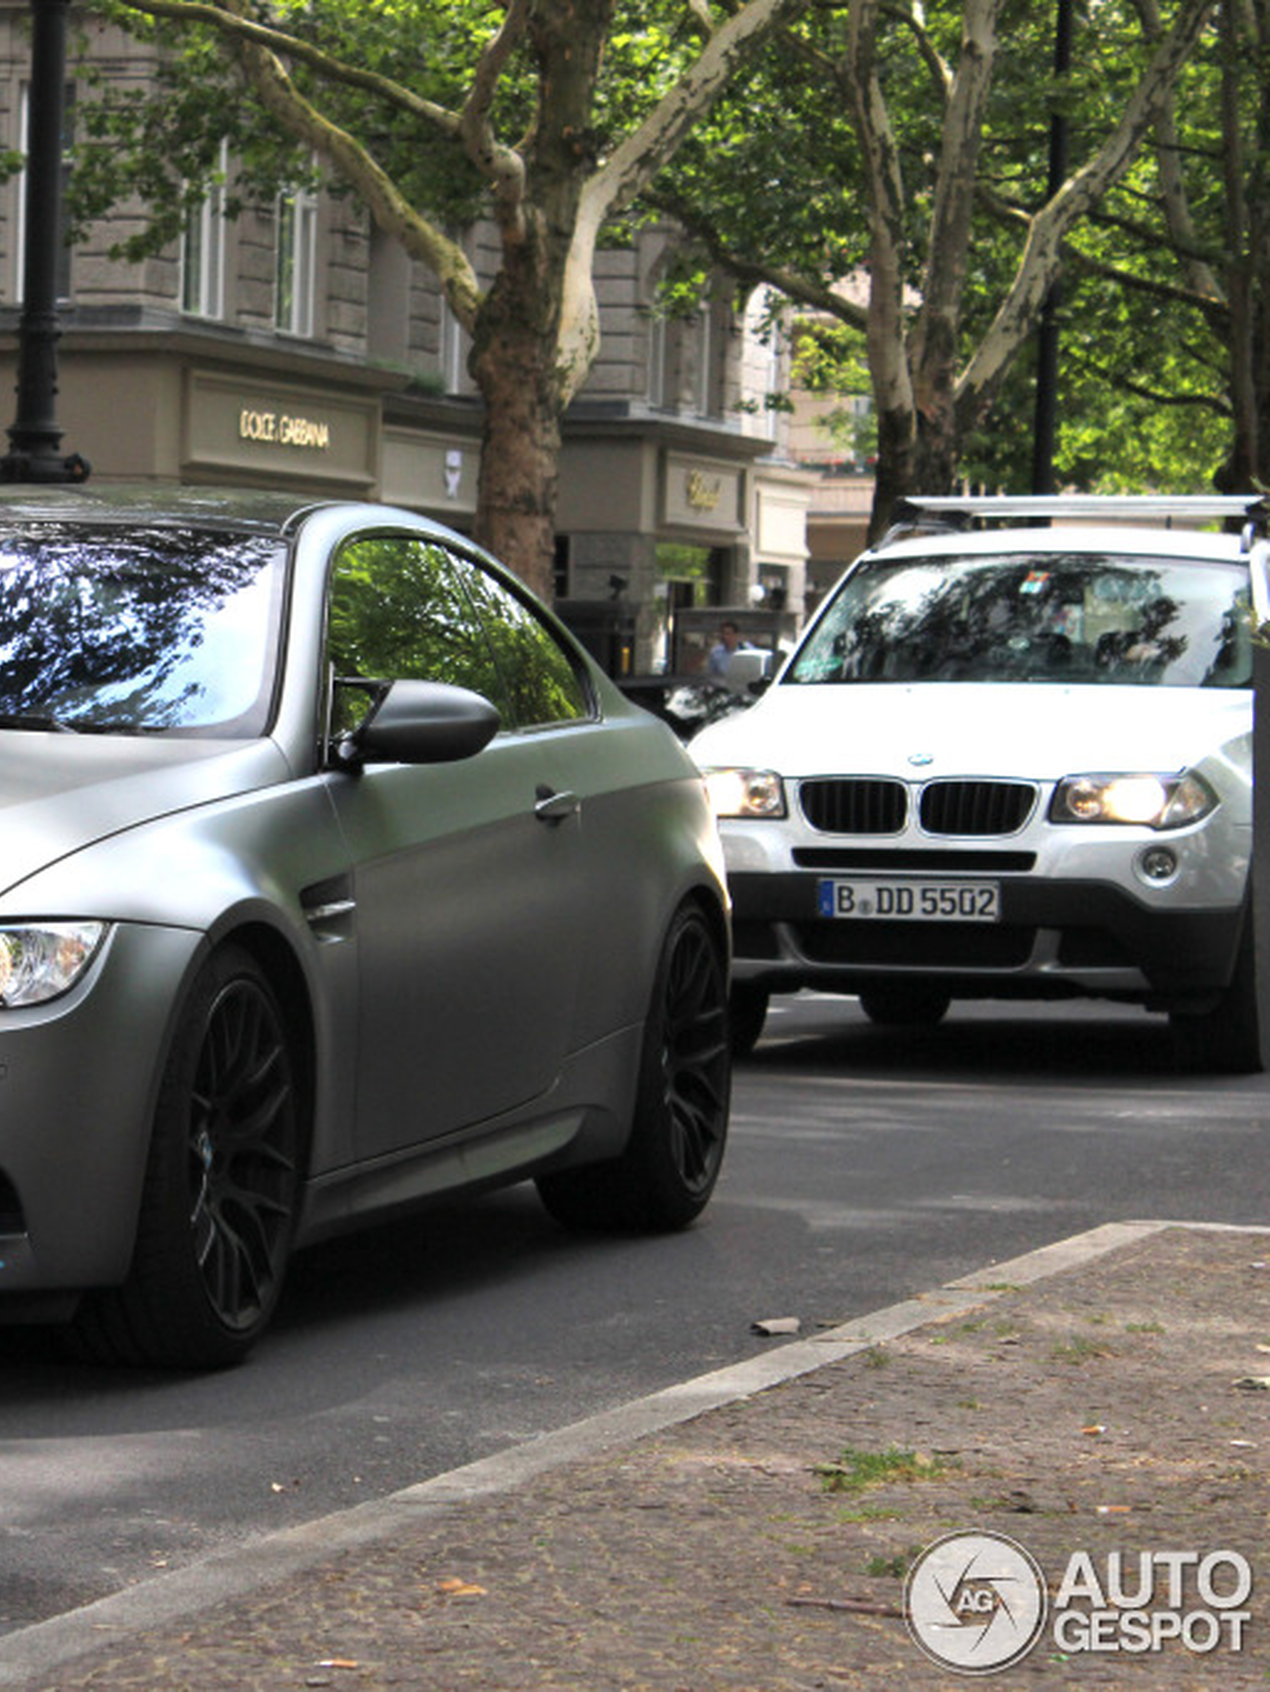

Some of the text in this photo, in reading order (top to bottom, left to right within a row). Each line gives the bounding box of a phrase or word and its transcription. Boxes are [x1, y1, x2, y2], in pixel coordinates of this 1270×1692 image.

[837, 885, 995, 916] B DD 5502
